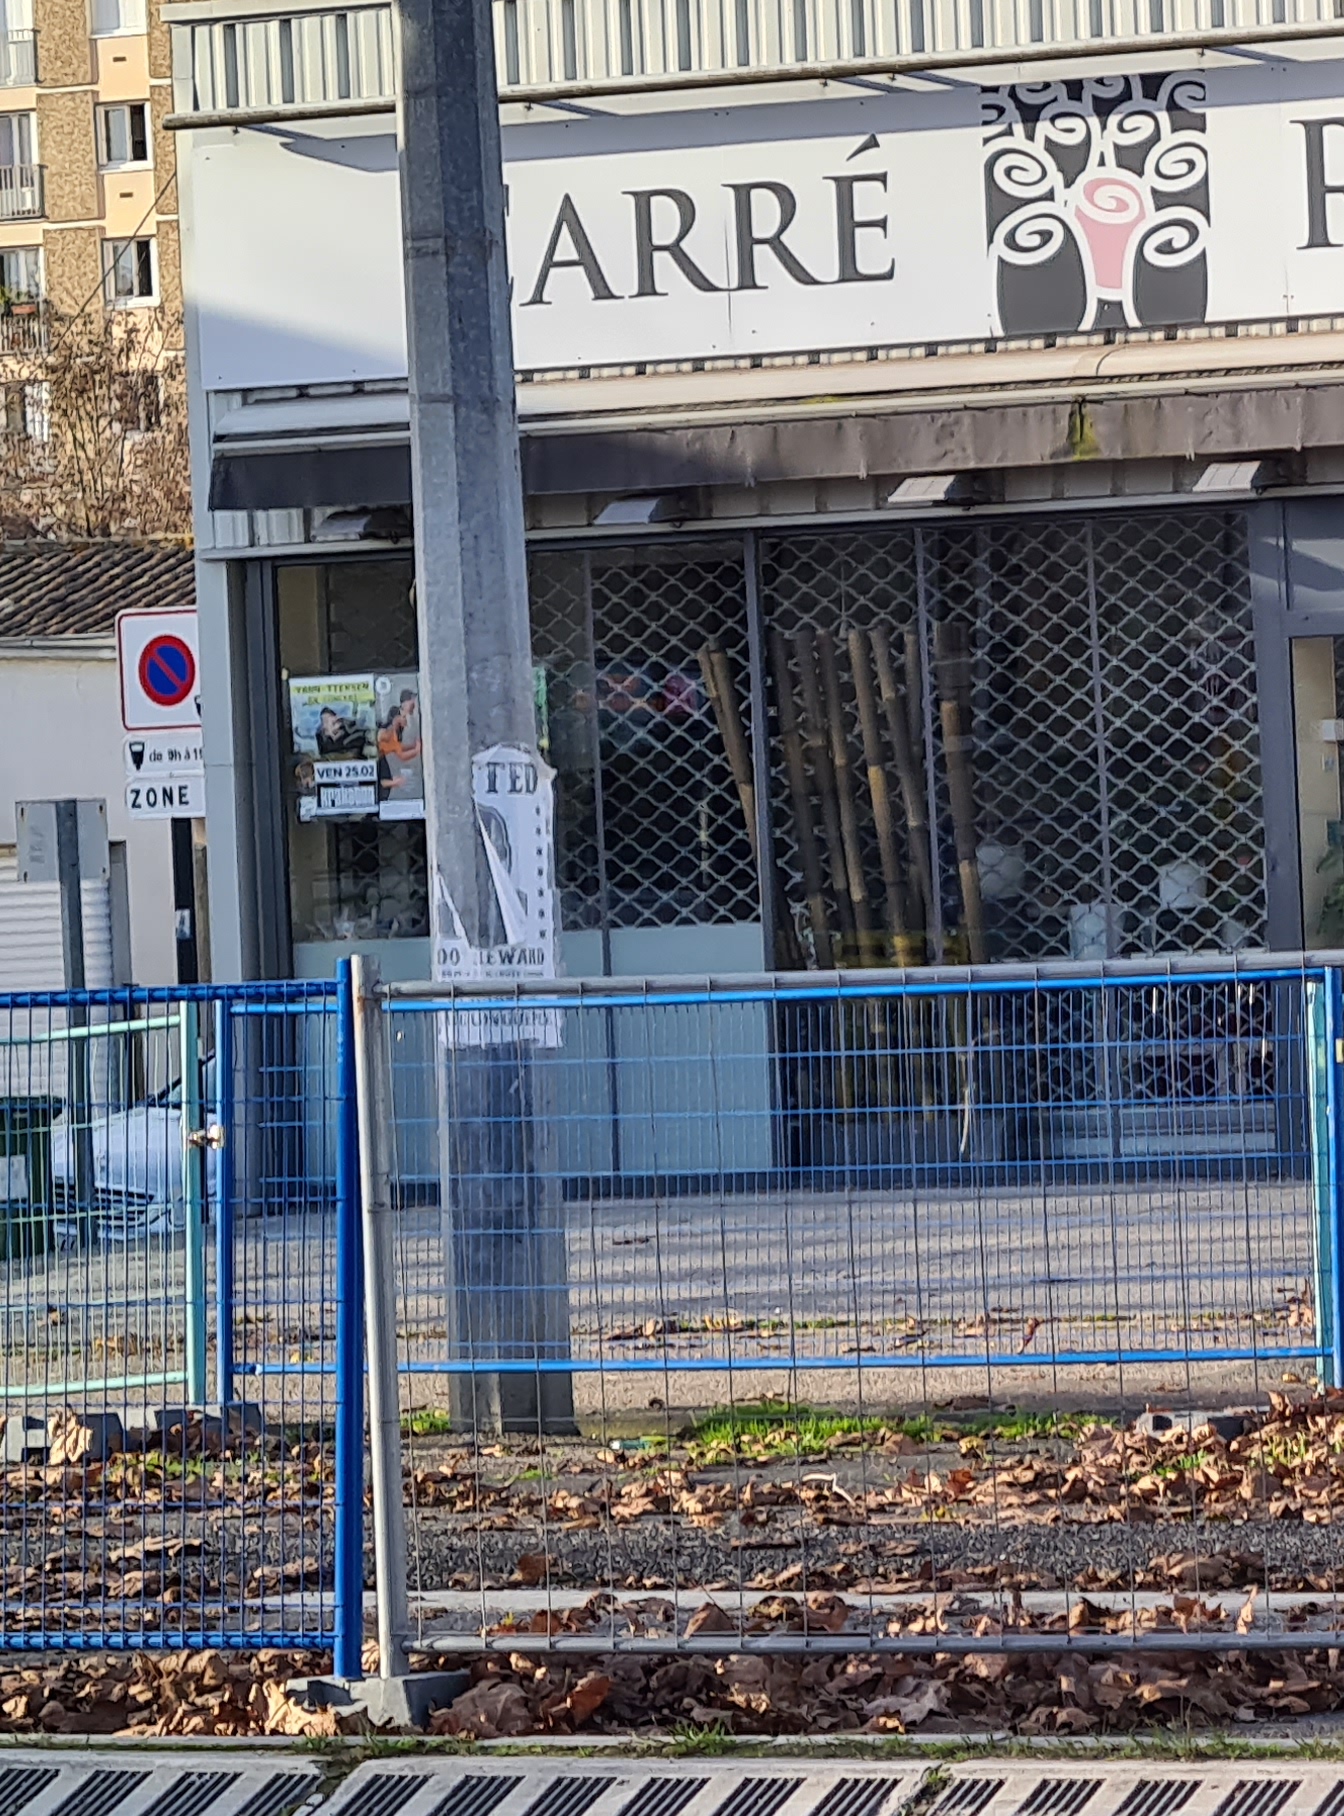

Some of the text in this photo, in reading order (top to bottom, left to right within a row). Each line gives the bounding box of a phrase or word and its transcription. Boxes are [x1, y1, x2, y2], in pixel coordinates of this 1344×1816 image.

[504, 134, 896, 307] ARRÉ
[316, 764, 375, 779] VEN 25.02
[478, 761, 539, 795] TED
[130, 784, 190, 810] ZONE
